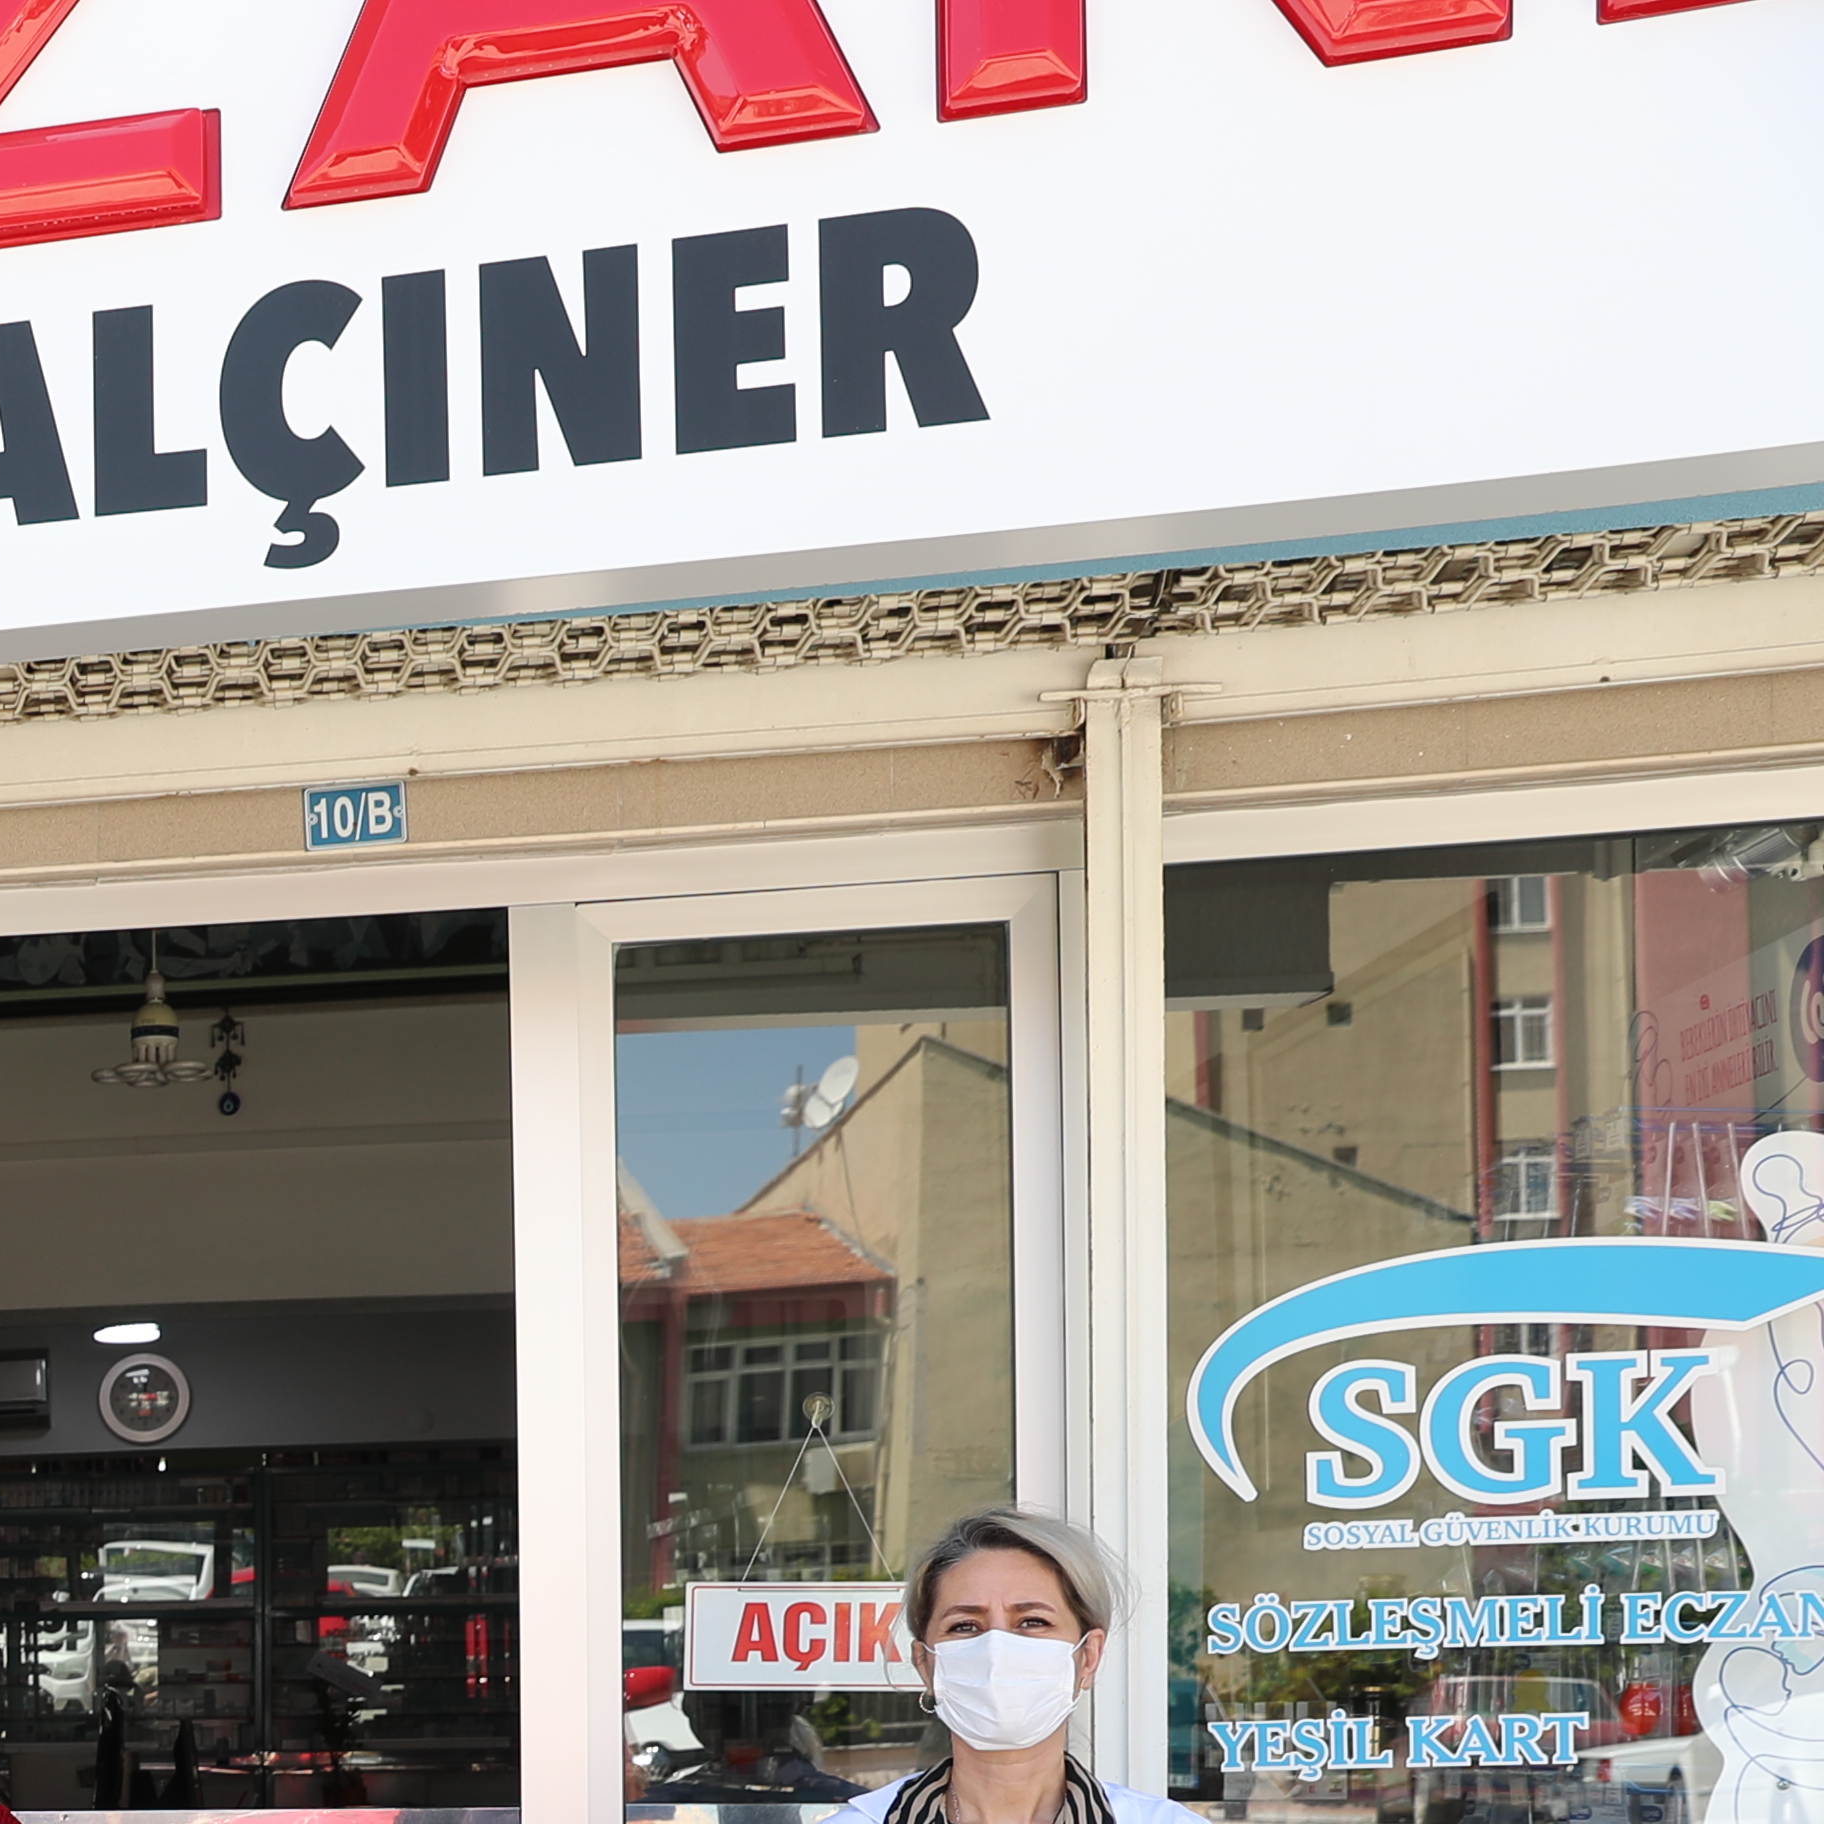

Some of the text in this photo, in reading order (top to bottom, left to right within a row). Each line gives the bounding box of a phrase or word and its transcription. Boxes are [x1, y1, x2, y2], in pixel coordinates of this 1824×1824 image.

[314, 791, 393, 841] 10/B
[1305, 1348, 1726, 1509] SGK
[1303, 1509, 1719, 1550] SOSYAL GÜVENLİK KURUMU
[731, 1601, 904, 1671] AÇIK
[1206, 1583, 1604, 1659] SÖZLEŞMELİ
[1206, 1708, 1588, 1781] YEŞİL KART
